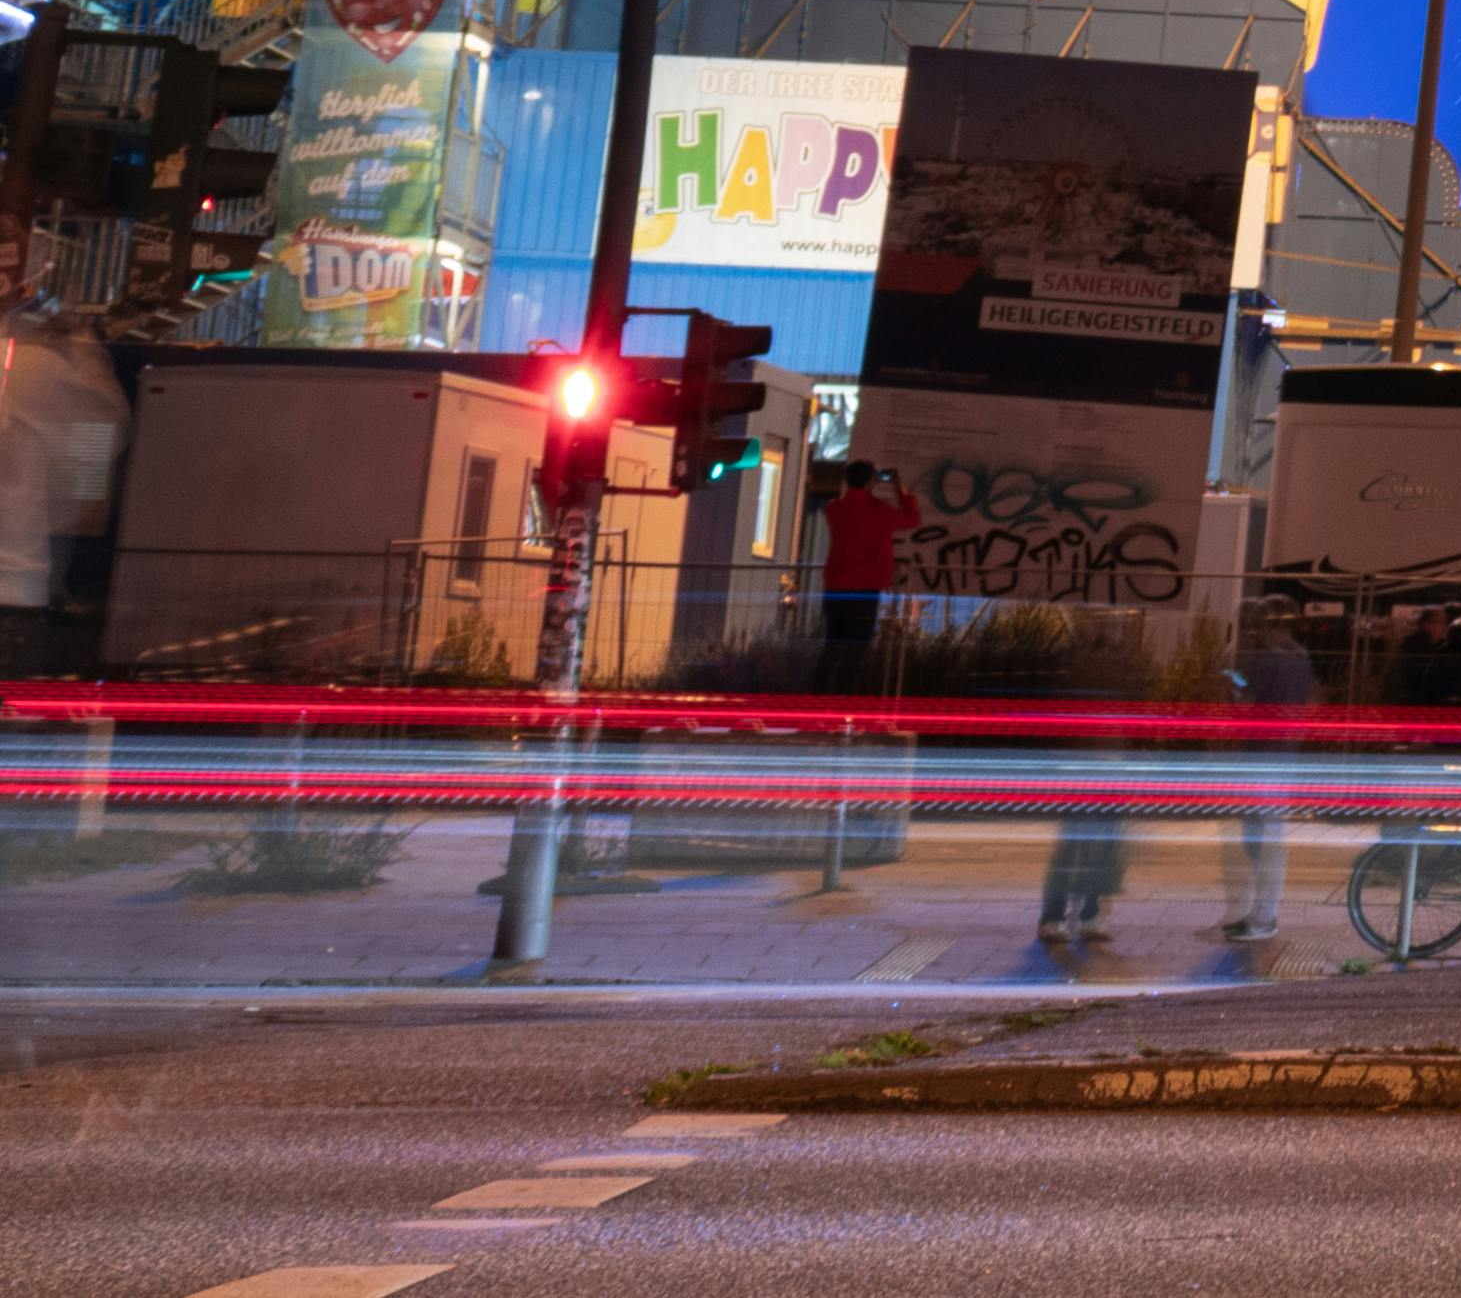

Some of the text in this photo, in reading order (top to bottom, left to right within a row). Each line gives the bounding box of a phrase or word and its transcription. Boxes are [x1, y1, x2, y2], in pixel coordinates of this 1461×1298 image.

[320, 80, 422, 121] Herzlich
[701, 69, 904, 102] DER IRRE SPA
[290, 125, 439, 162] willkommen
[308, 160, 411, 199] auf dem
[1042, 272, 1174, 302] SANIERUNG
[988, 302, 1216, 339] HEILIGENGEISTFELD
